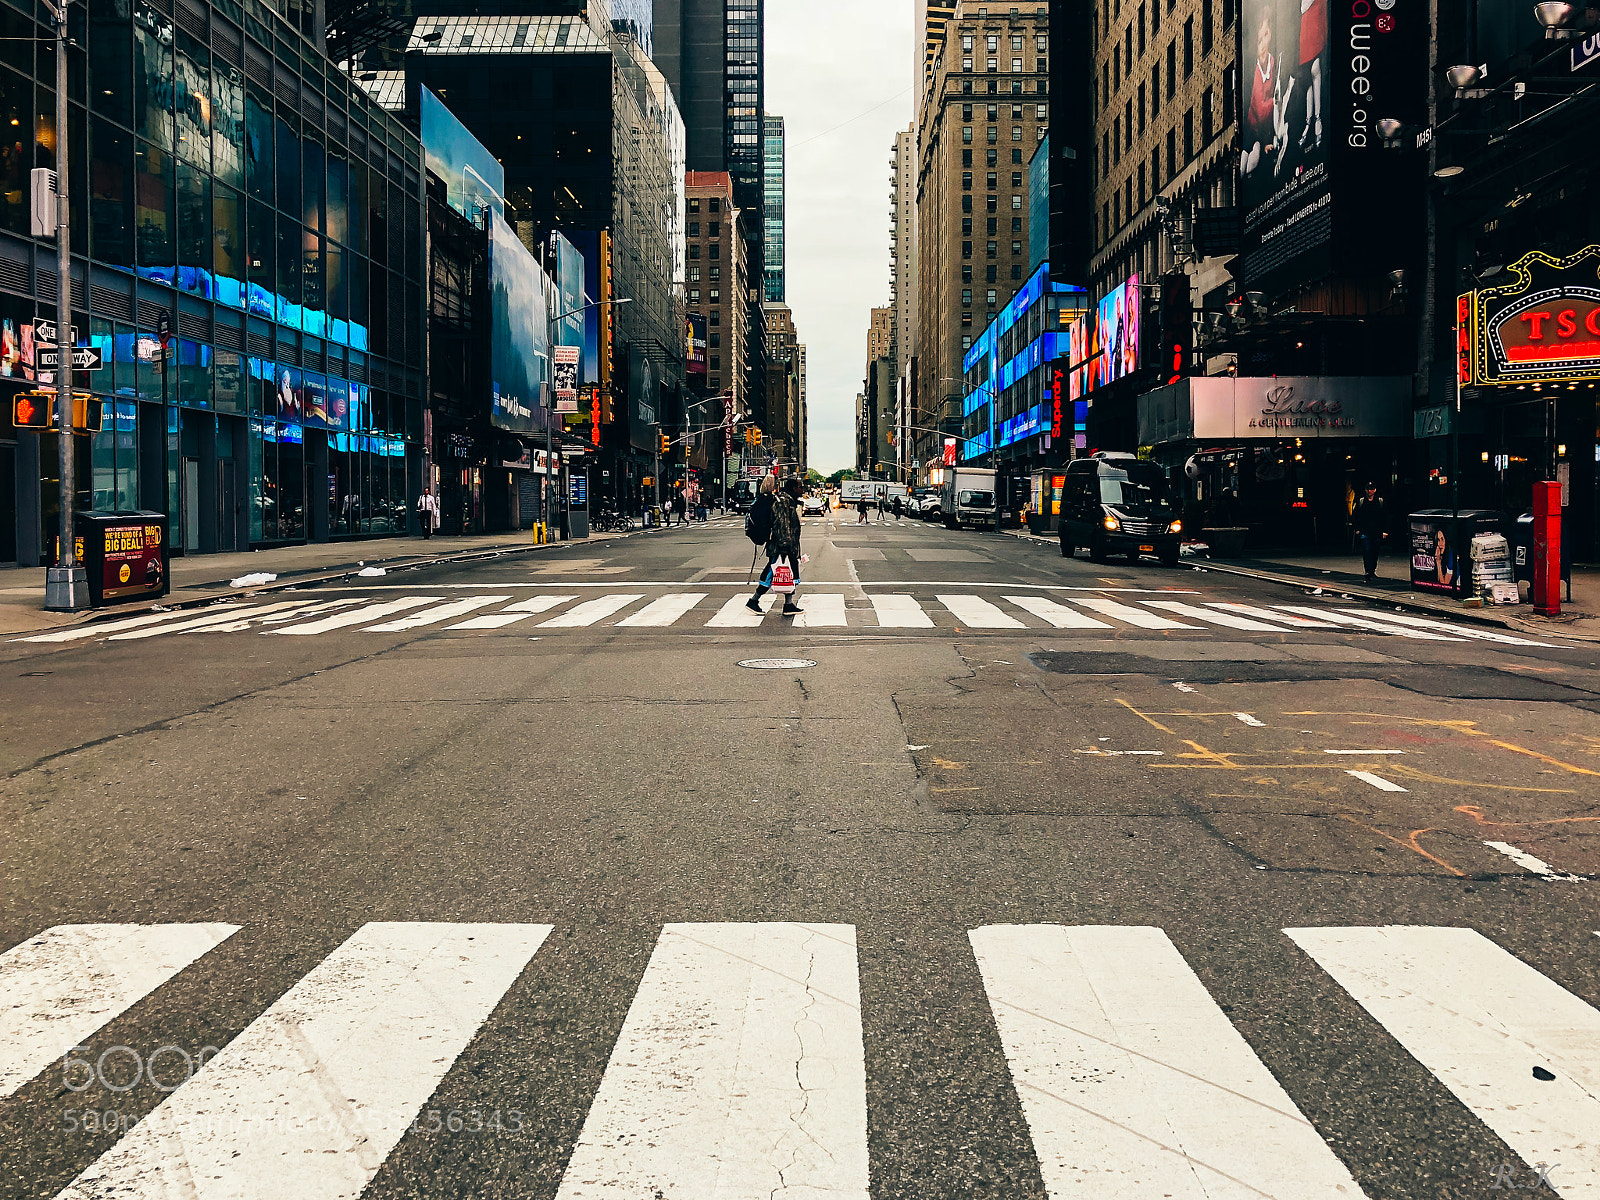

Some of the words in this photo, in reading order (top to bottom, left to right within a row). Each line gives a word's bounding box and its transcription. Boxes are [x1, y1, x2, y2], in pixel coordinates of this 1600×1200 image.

[40, 326, 54, 337] ONE
[104, 539, 120, 552] BIG
[120, 537, 144, 551] DEAL!
